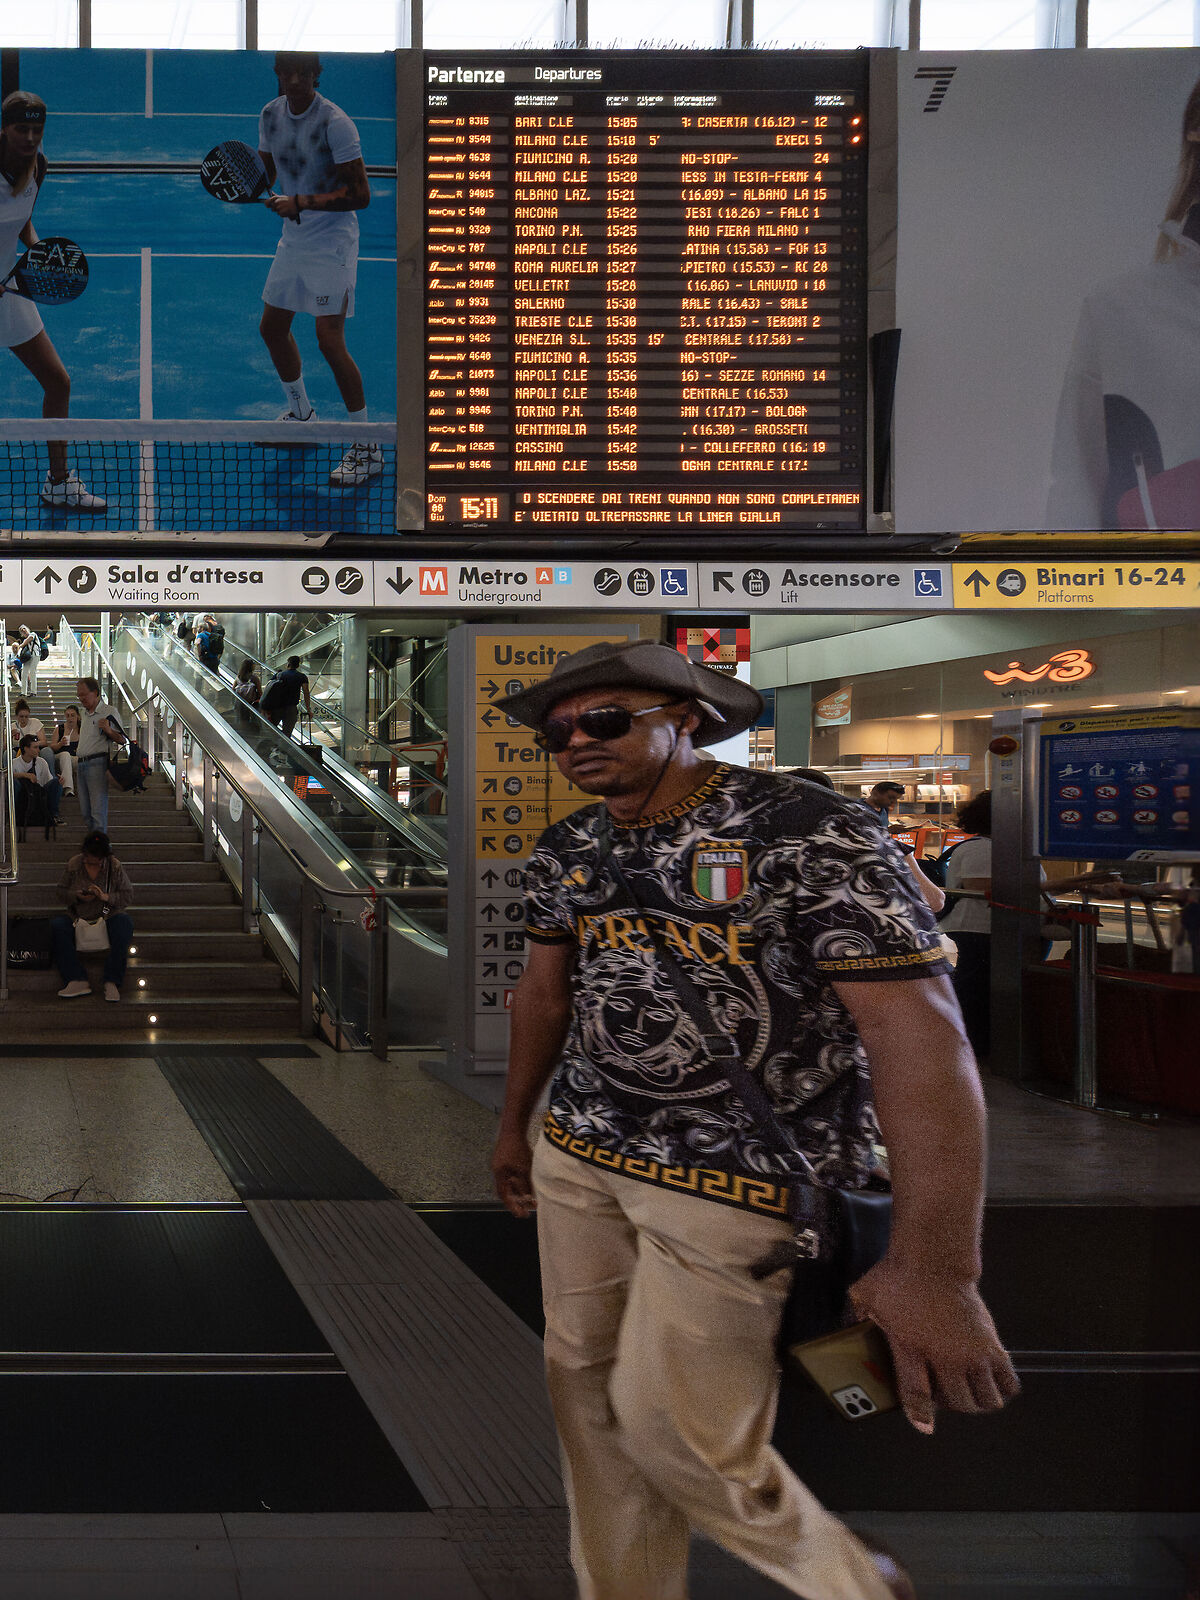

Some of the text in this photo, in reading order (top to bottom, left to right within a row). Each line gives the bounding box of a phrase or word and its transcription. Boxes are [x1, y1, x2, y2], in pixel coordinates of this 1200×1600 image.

[428, 68, 602, 83] Partenze Departures
[516, 117, 542, 127] BARI
[608, 117, 637, 128] 15:05
[698, 117, 748, 127] CASERTA
[754, 117, 795, 127] (16.12)
[814, 116, 828, 127] 12
[516, 153, 573, 164] FIUMICINO
[608, 153, 637, 164] 15:20
[814, 153, 829, 164] 24
[515, 207, 558, 218] ANCONA
[607, 207, 637, 218] 15:22
[685, 207, 712, 219] JESI
[688, 225, 799, 237] RHO FIERA MILANO
[27, 242, 83, 268] EA7
[515, 280, 798, 291] VELLETRI LANUVIO
[515, 334, 563, 345] VENEZIA
[607, 334, 636, 345] 15:35
[684, 334, 742, 345] CENTRALE
[719, 370, 826, 381] SEZZE ROMANO 14
[538, 493, 859, 504] SCENDERE DAI TRENI QUANDO NON SONO COMPLETAMEN
[460, 497, 498, 519] 15:11
[108, 565, 264, 585] Sala d'attesa
[458, 568, 528, 586] Metro
[781, 569, 900, 587] Ascensore
[1037, 568, 1185, 586] Binari 16-24
[108, 588, 200, 603] Waiting Room
[458, 588, 541, 604] Underground
[781, 590, 799, 603] Lift
[1038, 590, 1093, 603] Platforms
[495, 743, 555, 762] Tren
[527, 776, 552, 784] Binari
[699, 852, 742, 864] ITALIA
